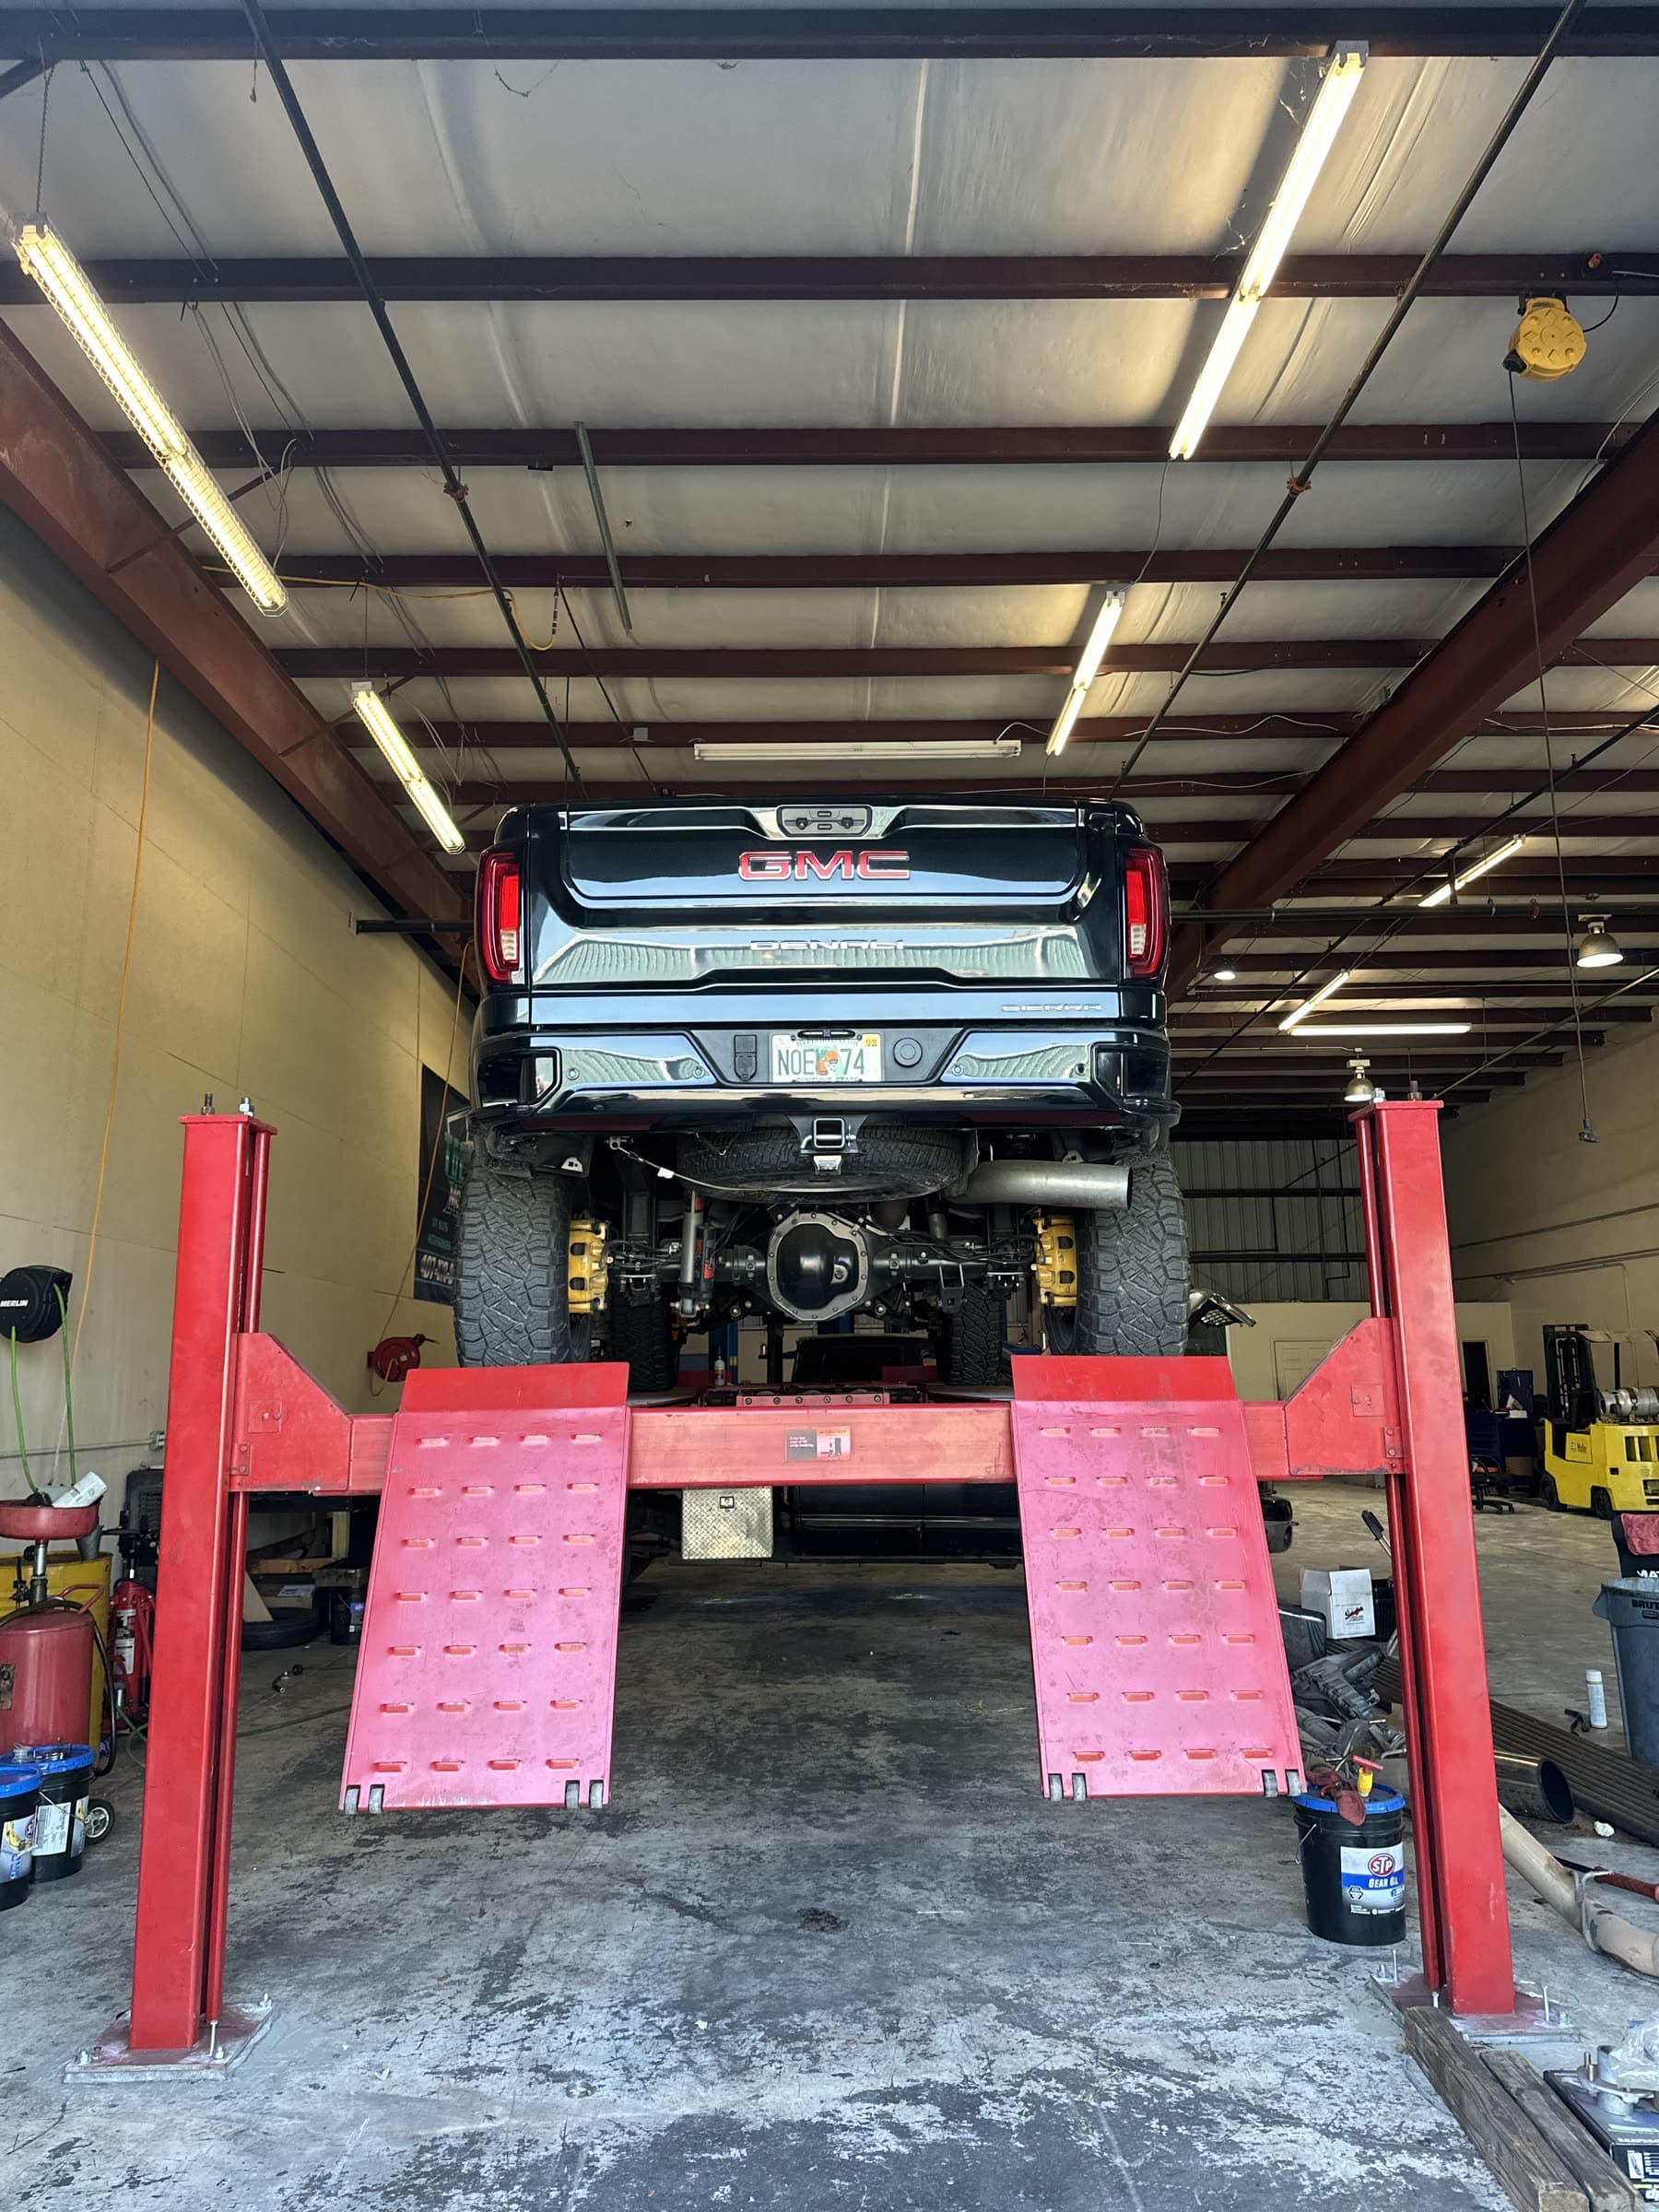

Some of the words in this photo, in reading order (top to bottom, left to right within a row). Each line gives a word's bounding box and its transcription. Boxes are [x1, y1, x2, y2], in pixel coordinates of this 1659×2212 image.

[738, 851, 910, 880] GMC
[749, 939, 905, 951] DENALI
[1002, 1004, 1102, 1012] SIERRA
[1372, 1856, 1393, 1874] STP
[1369, 1877, 1388, 1888] GEAR
[1389, 1876, 1399, 1887] OIL
